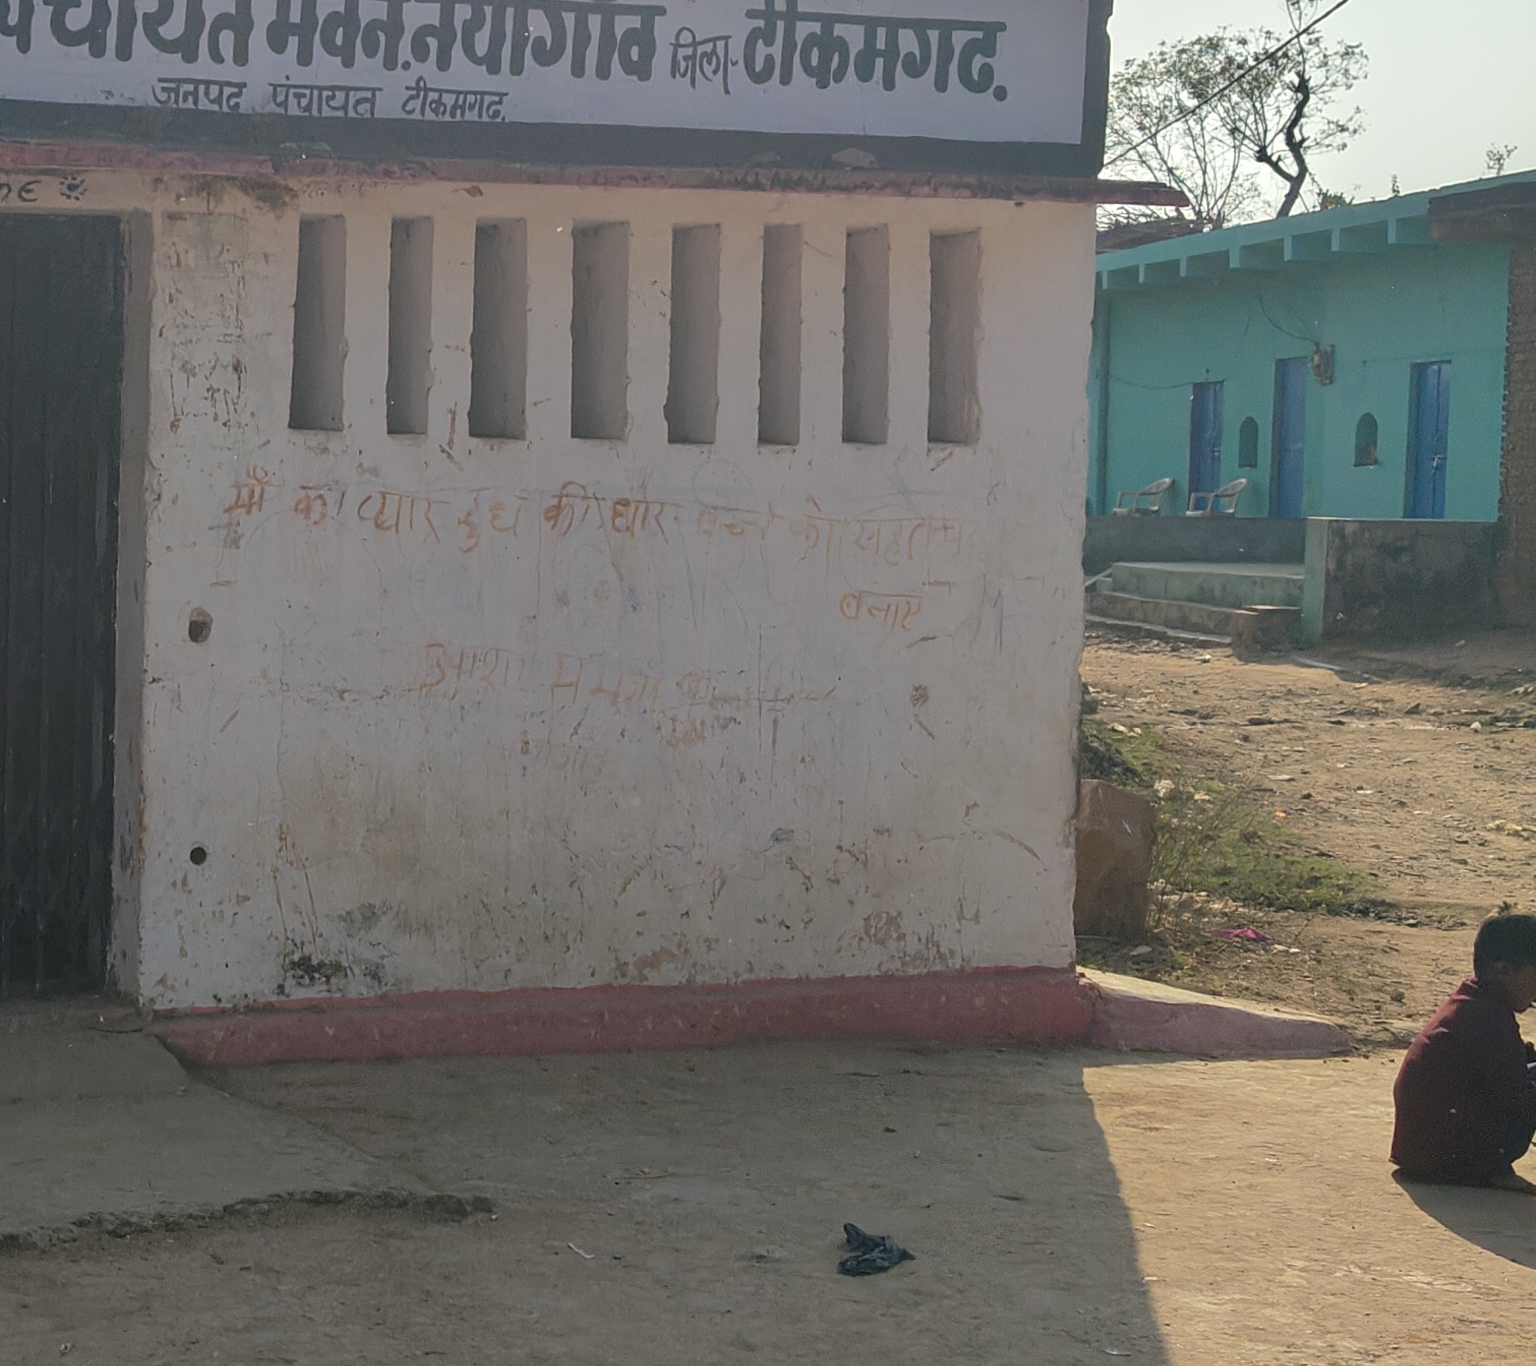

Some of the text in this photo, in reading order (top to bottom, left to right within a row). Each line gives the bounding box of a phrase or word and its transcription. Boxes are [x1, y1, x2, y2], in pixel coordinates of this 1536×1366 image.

[153, 75, 510, 122] जनपद पंचायत टीकमगढ़
